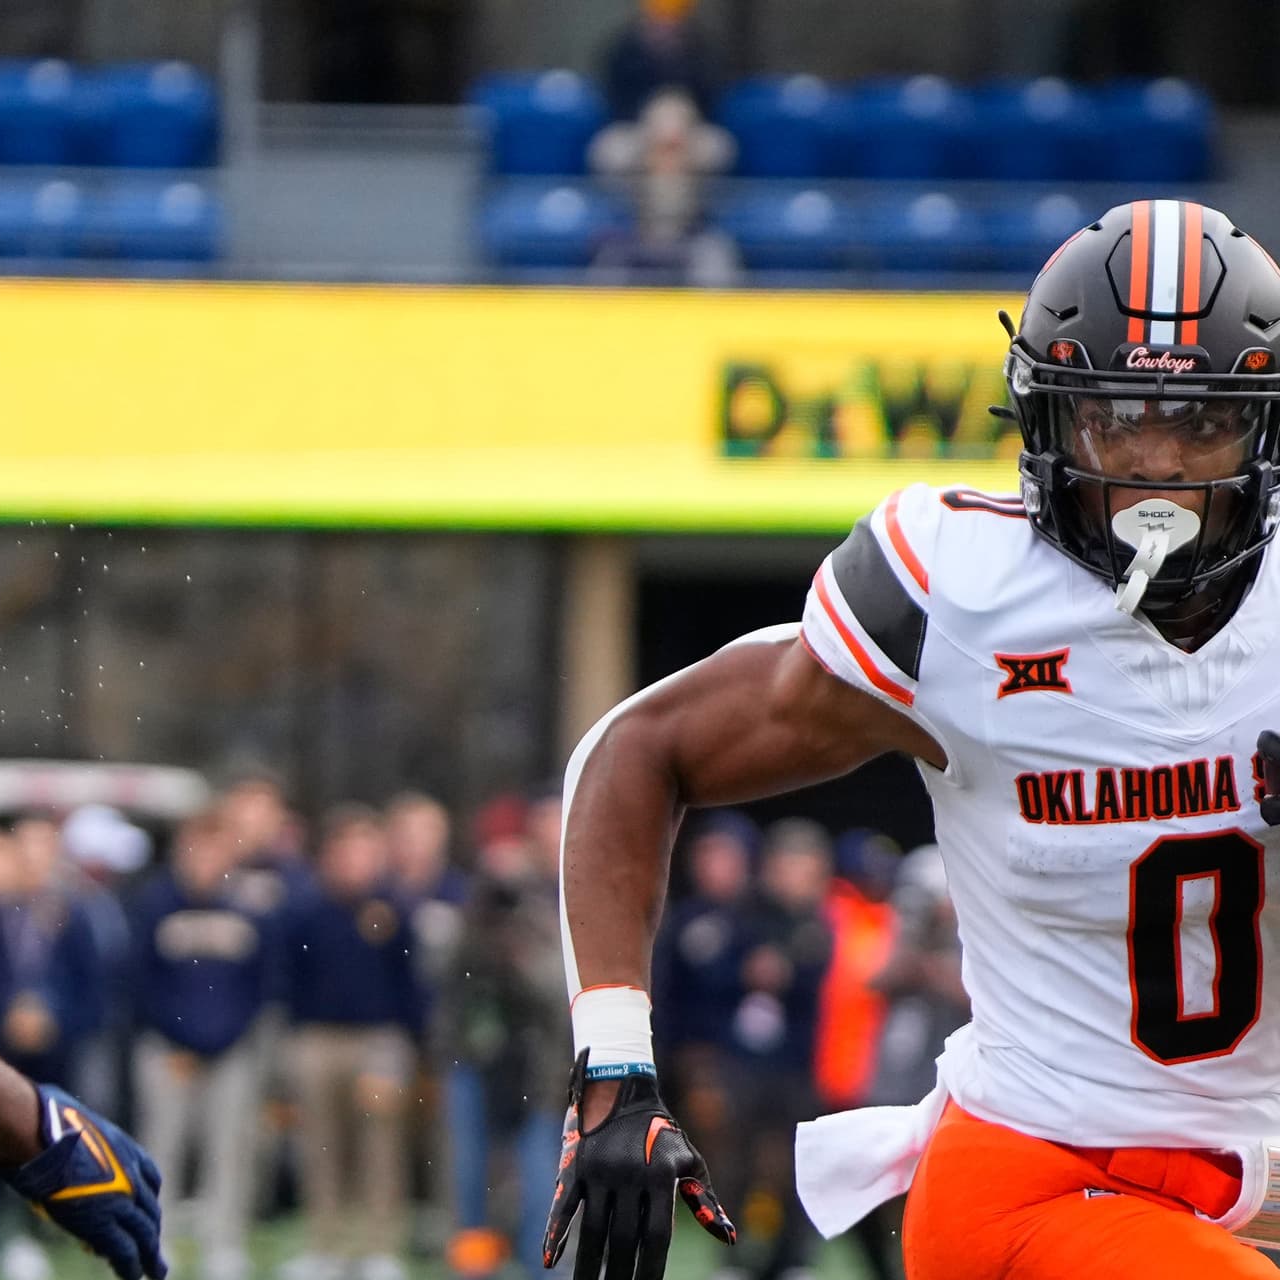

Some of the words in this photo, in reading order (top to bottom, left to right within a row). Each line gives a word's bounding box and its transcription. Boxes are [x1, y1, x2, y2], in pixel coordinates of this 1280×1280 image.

[1126, 346, 1196, 374] Cowboys
[1137, 510, 1176, 518] SHOCK
[1016, 755, 1241, 824] OKLAHOMA
[1127, 827, 1266, 1066] 0
